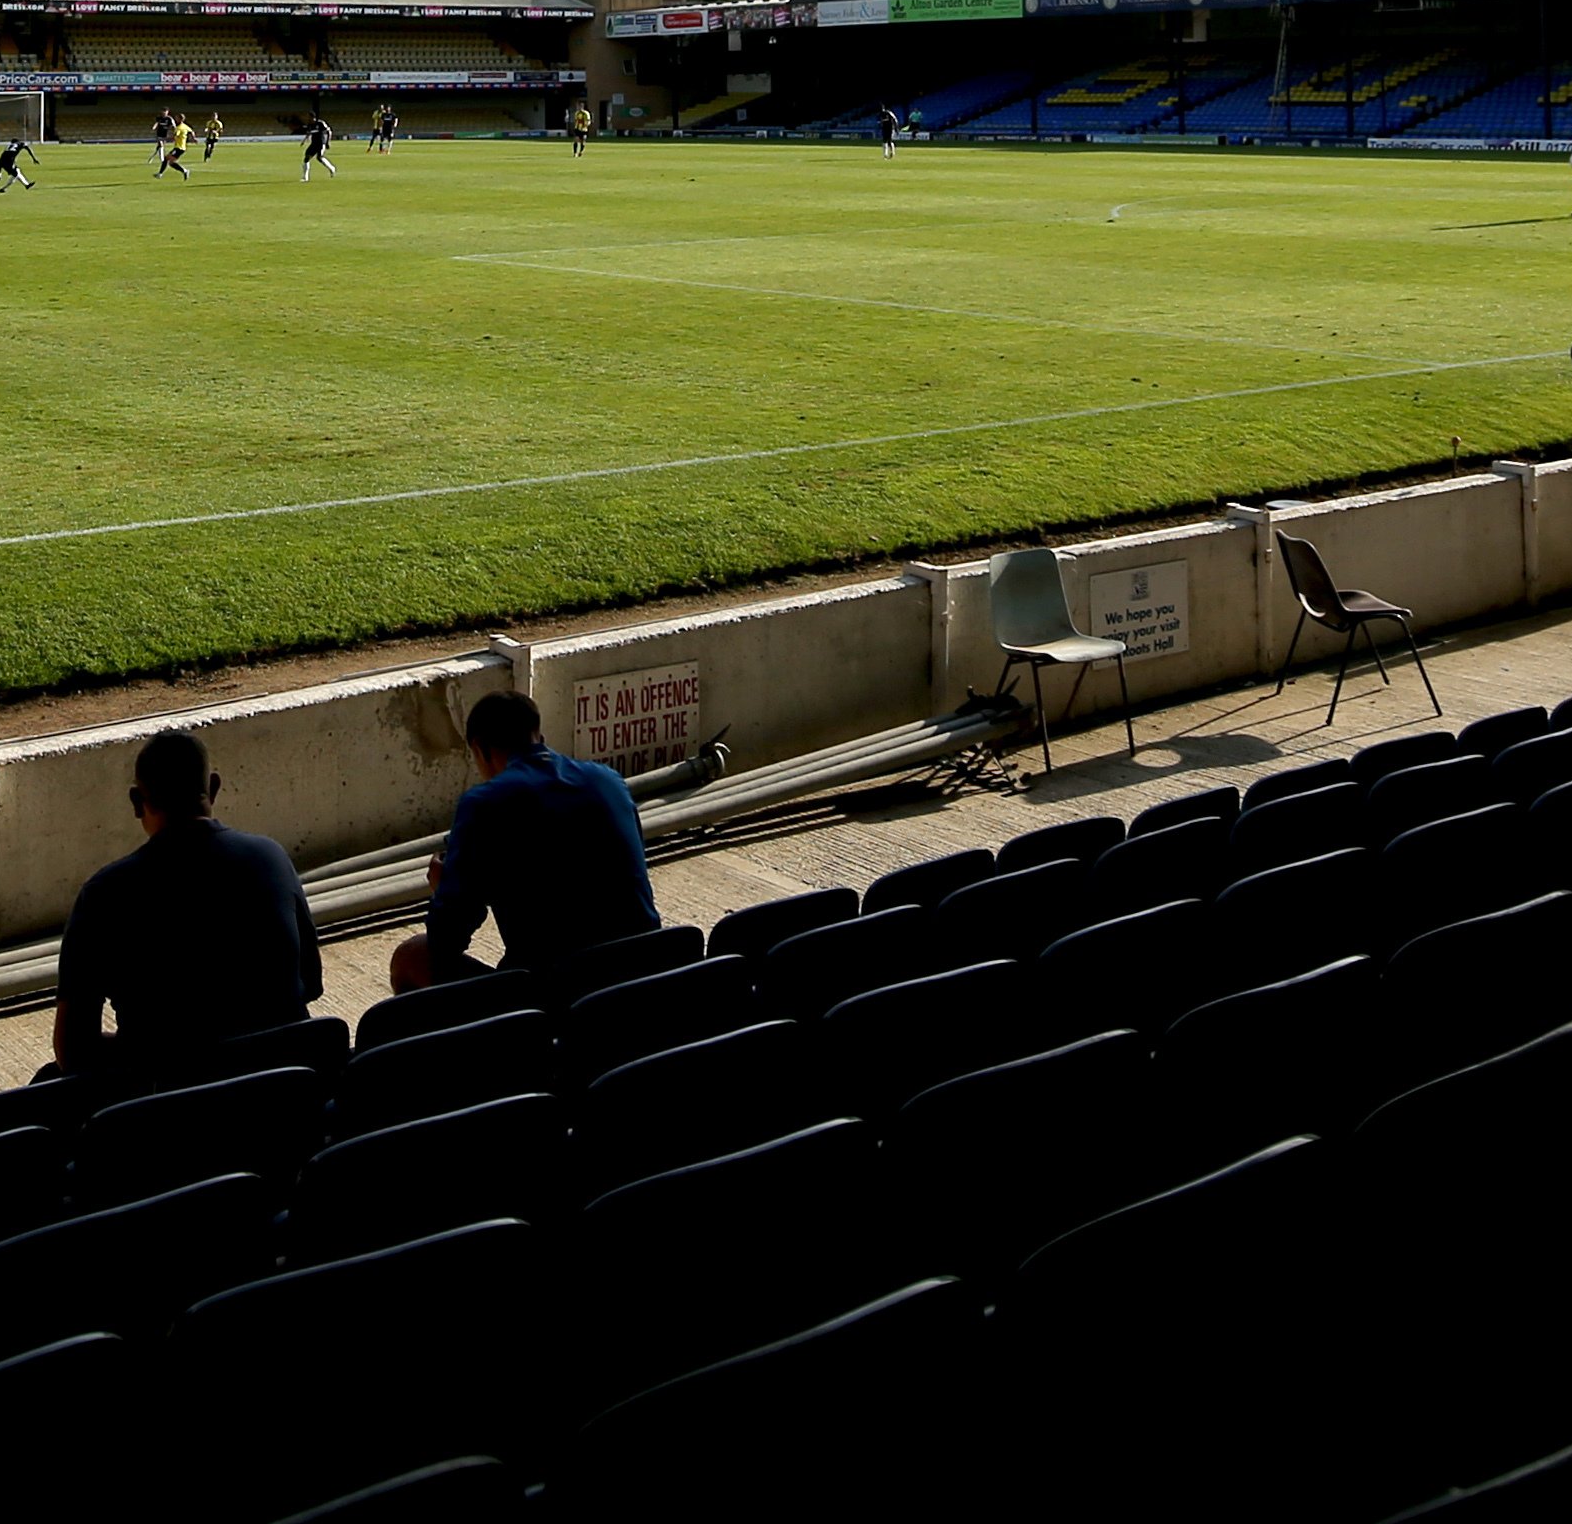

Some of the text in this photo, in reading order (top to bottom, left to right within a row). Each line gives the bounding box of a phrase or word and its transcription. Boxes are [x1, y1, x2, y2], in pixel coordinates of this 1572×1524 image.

[1105, 604, 1175, 625] We hope you
[1133, 625, 1157, 641] your
[1160, 618, 1181, 632] visit
[1154, 636, 1174, 652] Hall
[577, 677, 699, 725] IT IS AN OFFENCE
[589, 711, 688, 754] TO ENTER THE
[631, 749, 649, 776] OF
